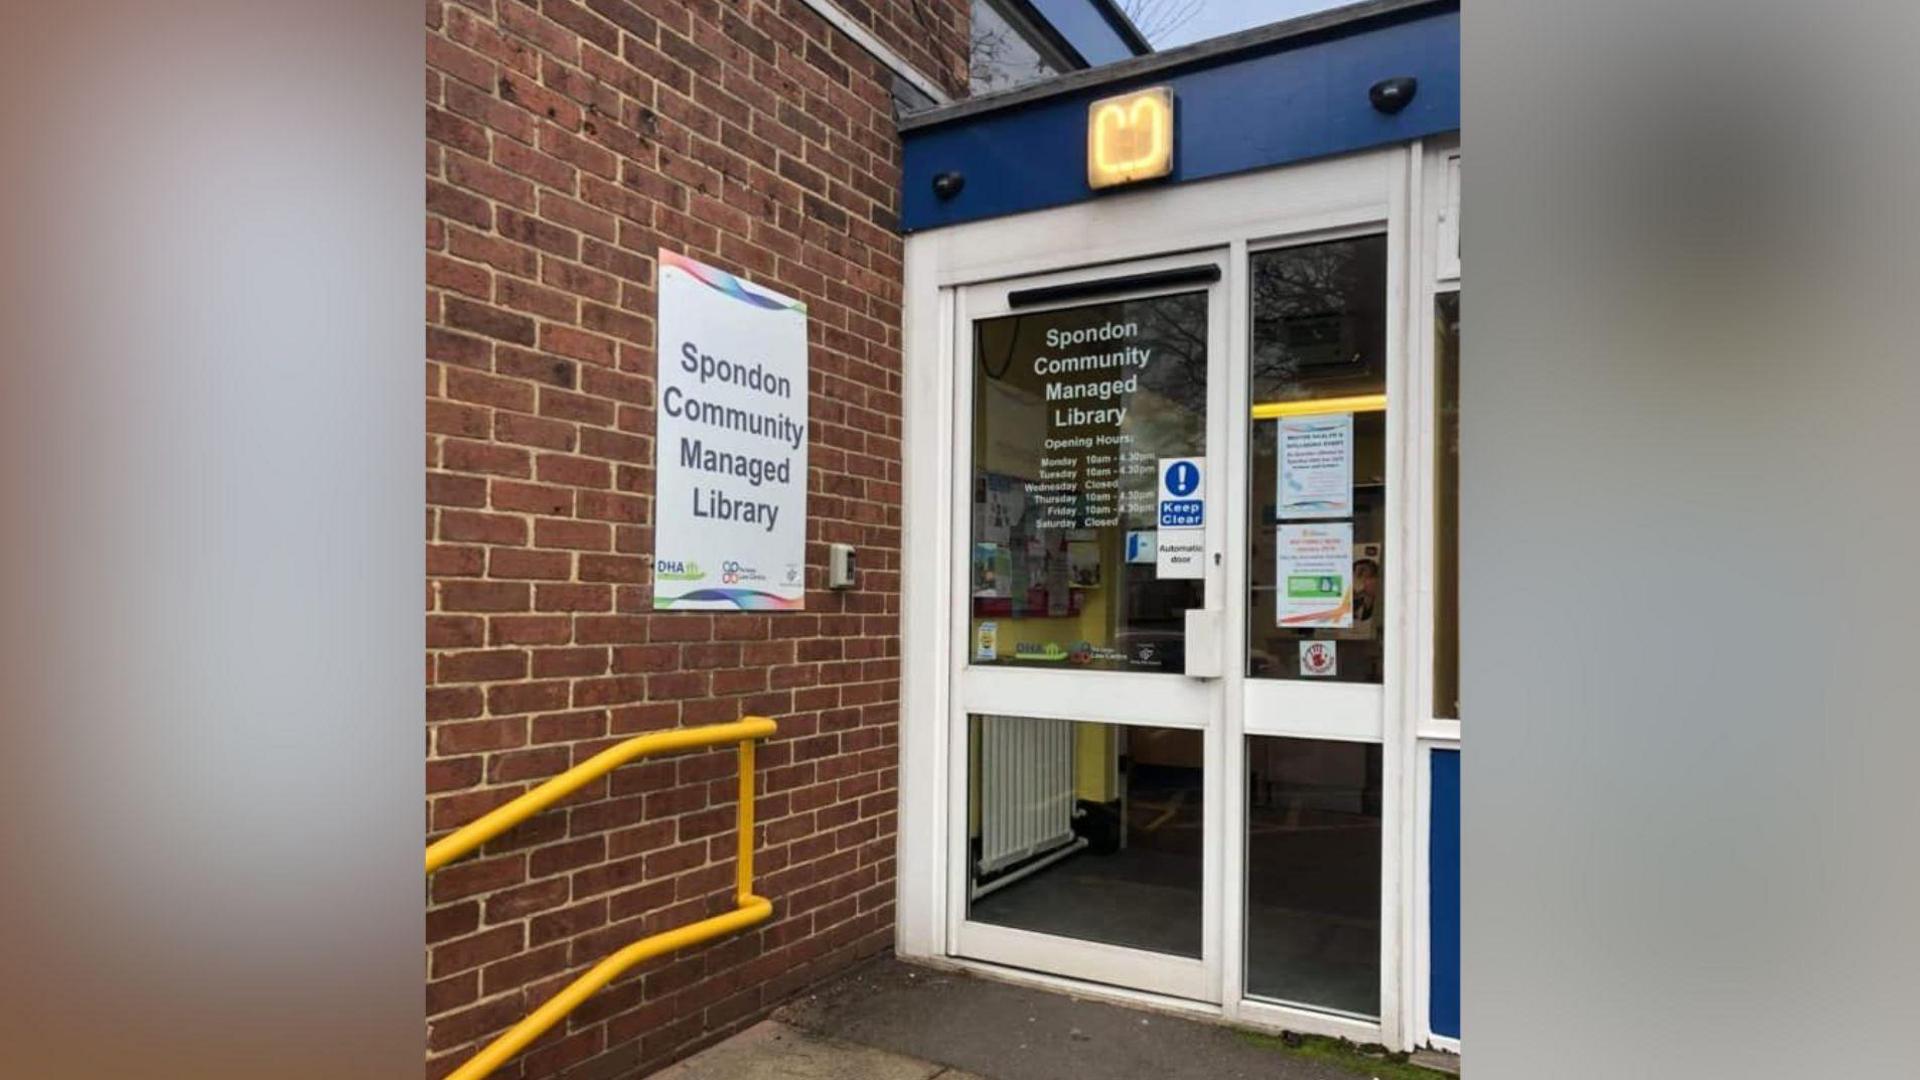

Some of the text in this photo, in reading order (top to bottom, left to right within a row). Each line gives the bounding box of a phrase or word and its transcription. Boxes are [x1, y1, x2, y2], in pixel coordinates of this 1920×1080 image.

[1046, 322, 1138, 349] Spondon
[1034, 347, 1151, 375] Community
[681, 342, 791, 398] Spondon
[1046, 374, 1137, 400] Managed
[663, 386, 804, 450] Community
[1055, 407, 1127, 427] Library
[1044, 435, 1135, 450] Opening Hours:
[680, 437, 790, 487] Managed
[1041, 457, 1077, 467] Monday
[1086, 455, 1111, 464] 10am
[1040, 470, 1077, 479] Tuesday
[1086, 468, 1111, 477] 10am
[1025, 480, 1118, 492] Wednesday Closed
[1035, 495, 1077, 504] Thursday
[1086, 493, 1110, 502] 10am
[693, 487, 779, 532] Library
[1048, 507, 1077, 516] Friday
[1086, 505, 1110, 514] 10am
[1164, 503, 1199, 514] Keep
[1036, 518, 1119, 529] Saturday Closed
[1162, 514, 1200, 524] Clear
[1160, 544, 1203, 553] Automatic
[1171, 555, 1191, 563] door
[657, 560, 685, 573] DHA
